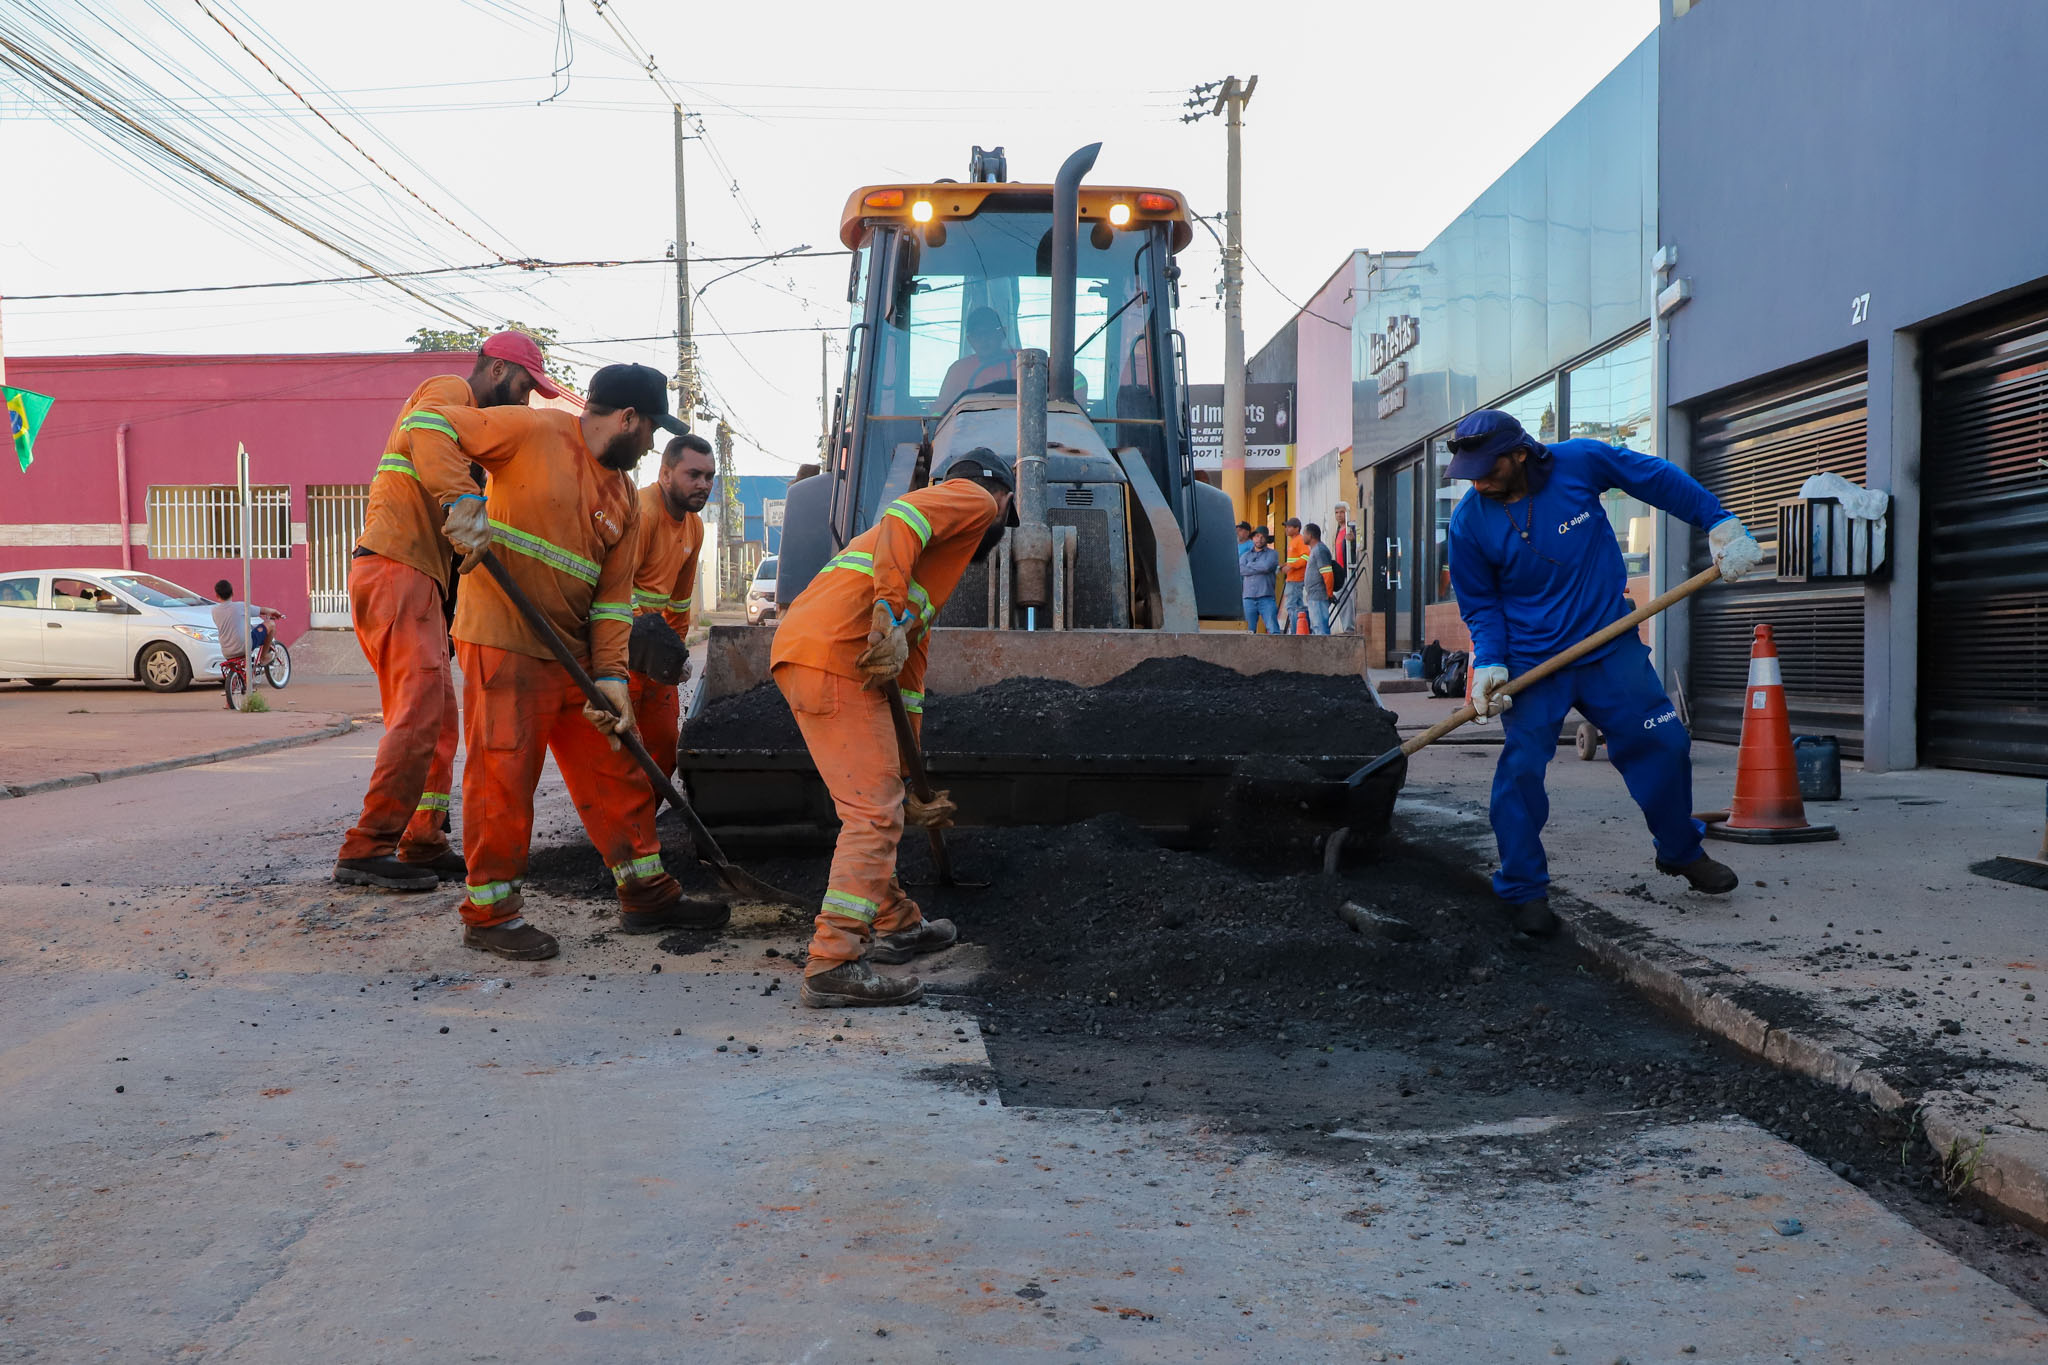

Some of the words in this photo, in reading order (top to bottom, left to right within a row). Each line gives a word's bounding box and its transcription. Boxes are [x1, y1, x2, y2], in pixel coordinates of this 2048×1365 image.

[1852, 292, 1870, 325] 27
[1203, 404, 1264, 423] Imts
[1570, 511, 1590, 525] alpha
[1657, 711, 1676, 724] alpha
